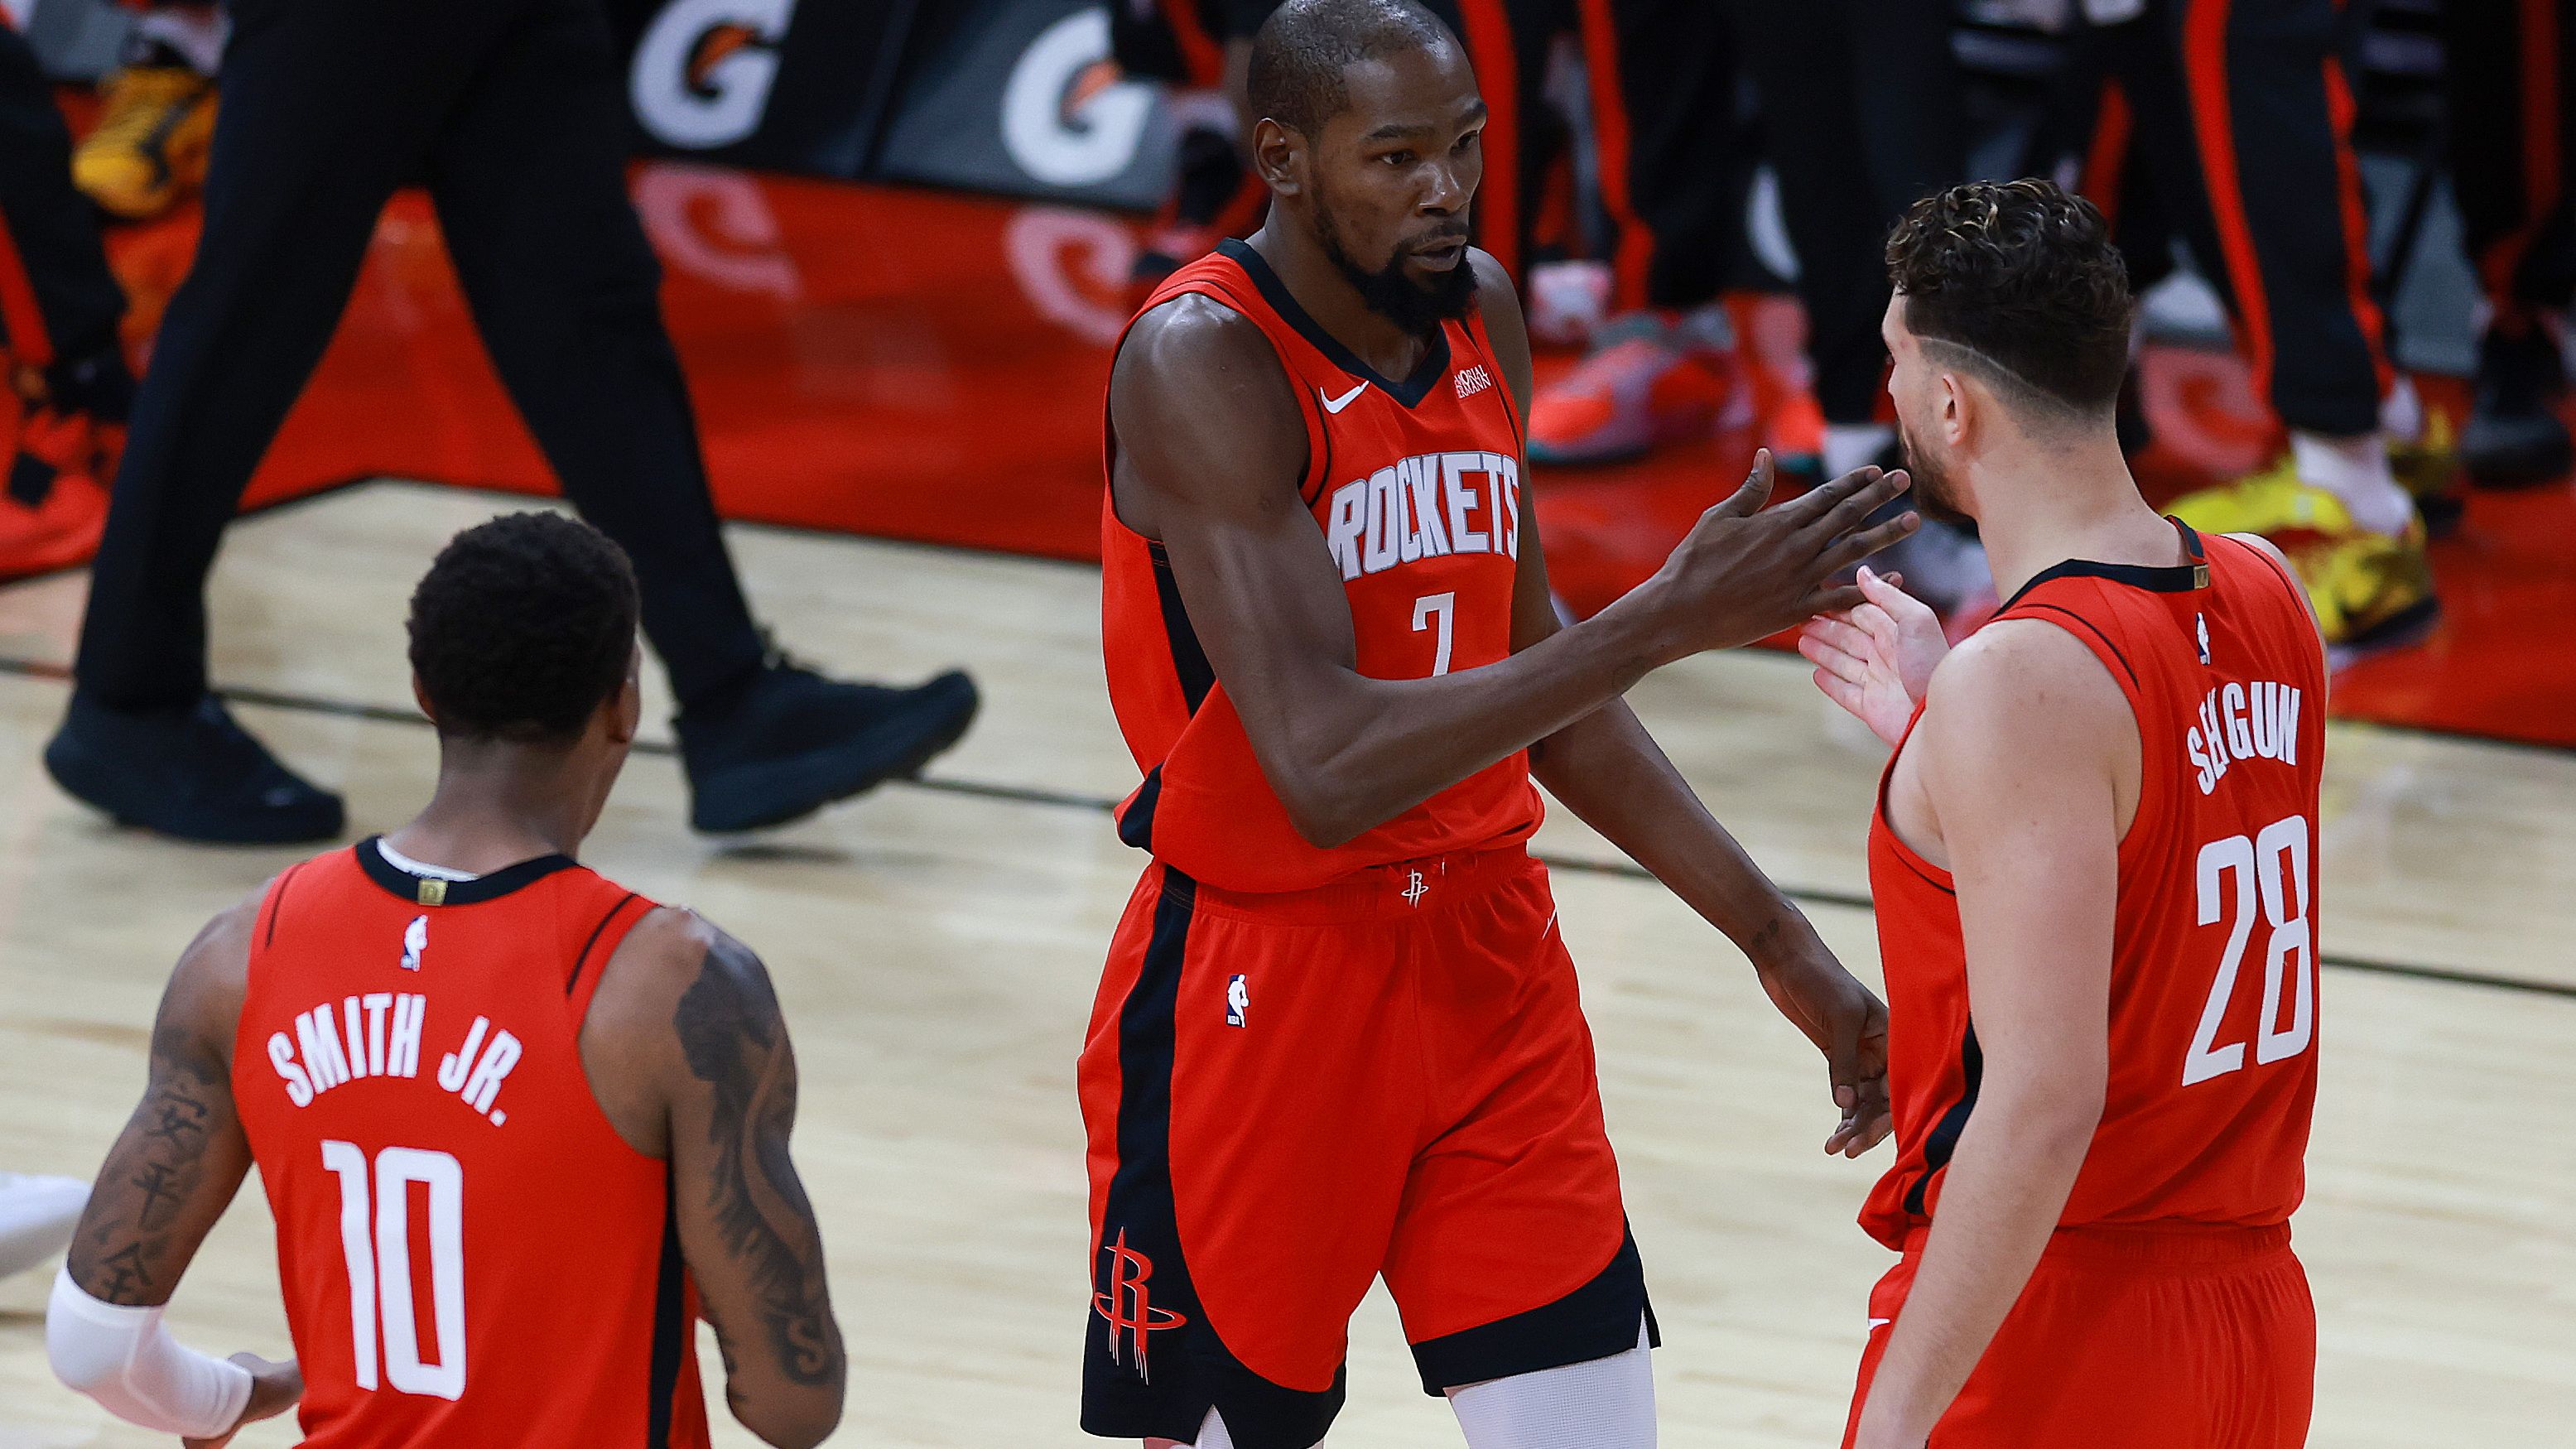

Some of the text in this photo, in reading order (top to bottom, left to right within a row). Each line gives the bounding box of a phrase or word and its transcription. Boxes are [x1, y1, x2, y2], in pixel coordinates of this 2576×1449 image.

[629, 0, 796, 150] G
[1001, 3, 1157, 186] G
[1327, 451, 1519, 581] ROCKETS
[1413, 592, 1455, 677] 7
[2182, 815, 2312, 1086] 28
[267, 993, 522, 1127] SMITH JR.
[320, 1138, 466, 1401] 10
